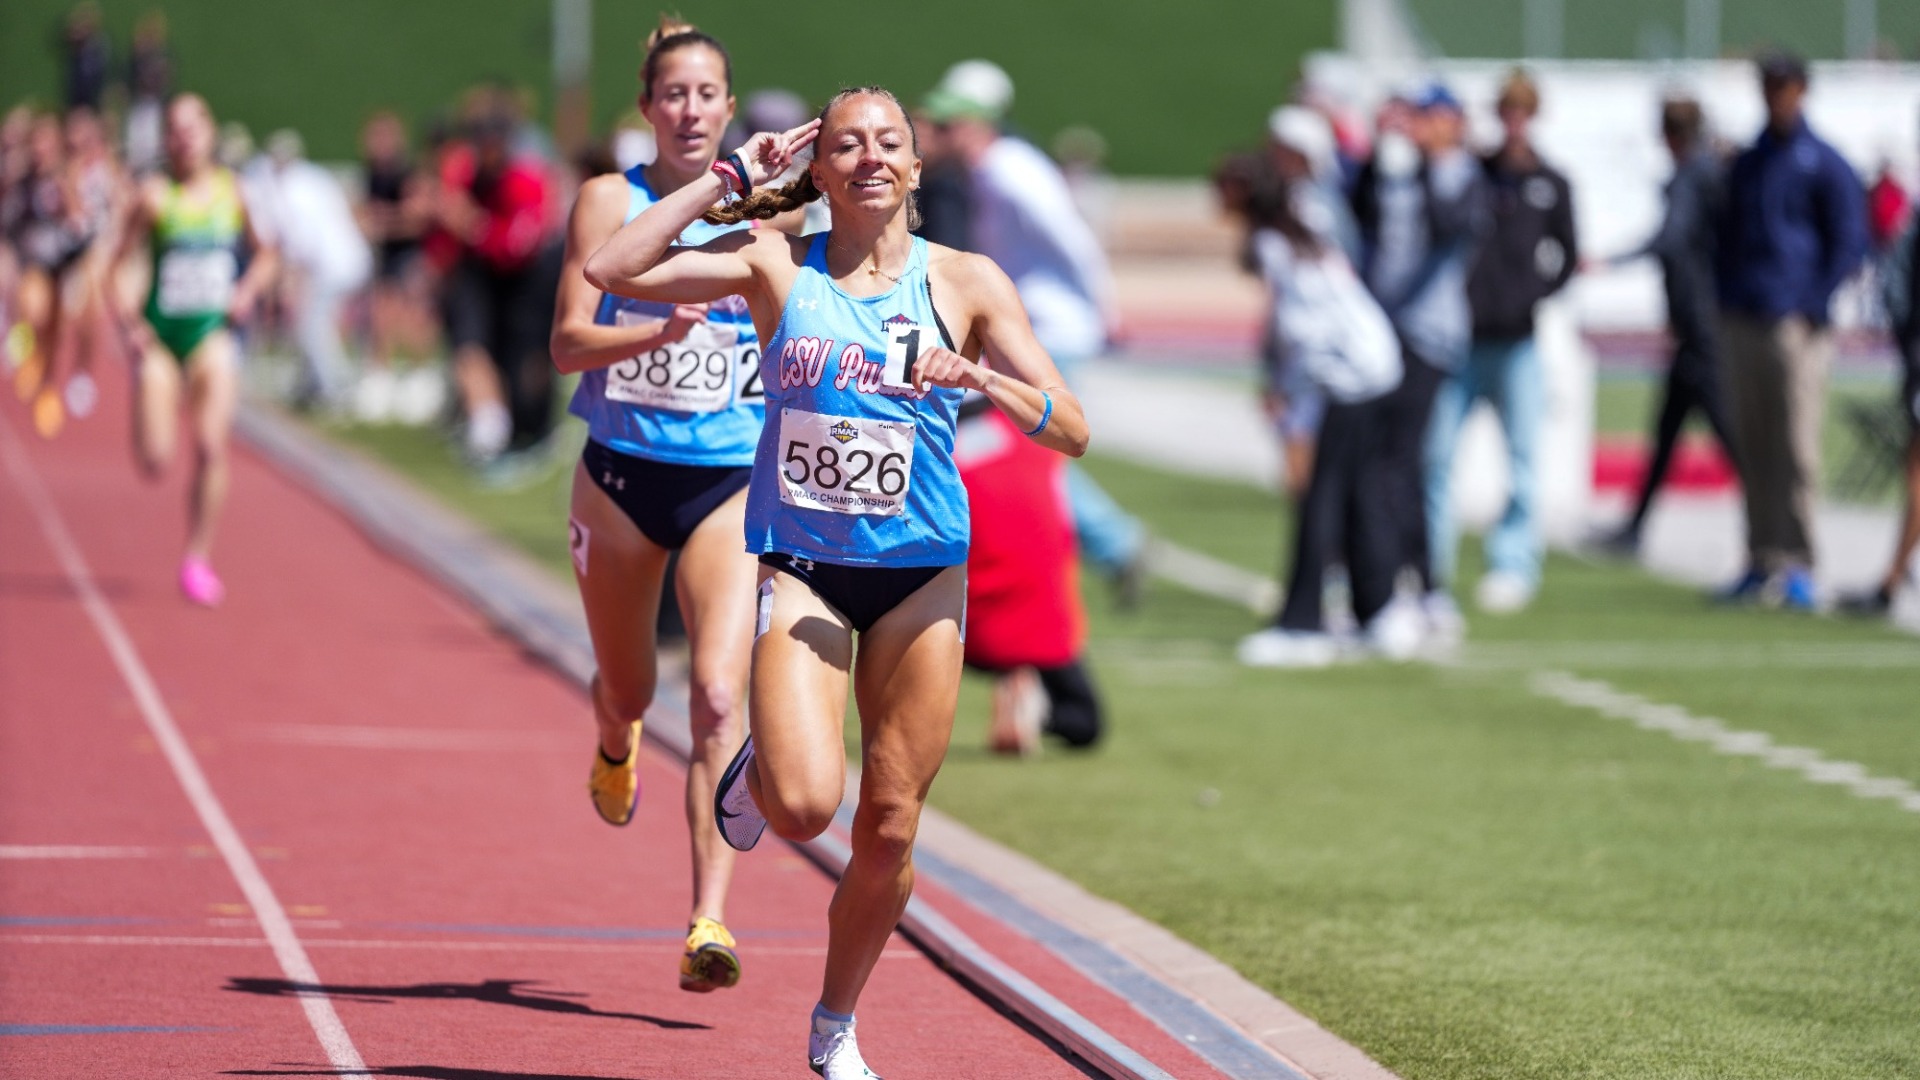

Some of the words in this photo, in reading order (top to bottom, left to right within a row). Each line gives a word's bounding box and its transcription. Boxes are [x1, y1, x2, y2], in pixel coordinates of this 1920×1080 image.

[741, 348, 764, 399] 2
[779, 335, 834, 390] CSU
[895, 329, 920, 384] 1
[830, 426, 859, 439] RMAC
[783, 440, 906, 496] 5826
[787, 488, 818, 501] RMAC
[820, 493, 896, 508] CHAMPIONSHIP
